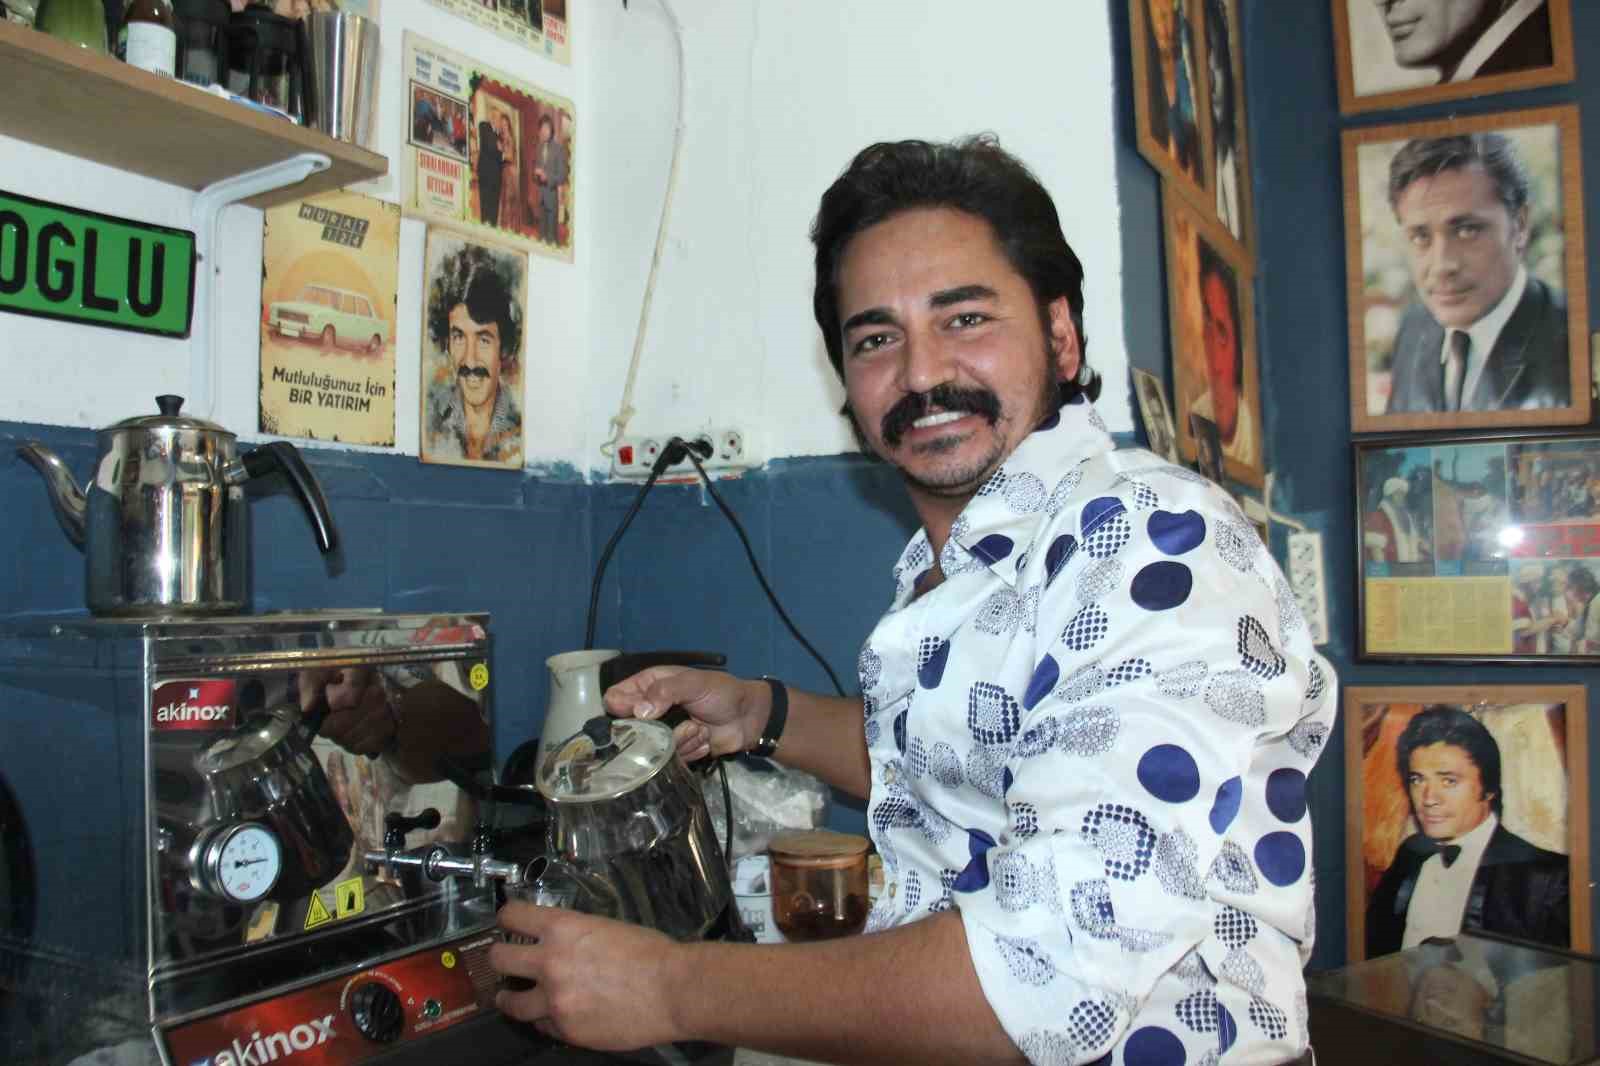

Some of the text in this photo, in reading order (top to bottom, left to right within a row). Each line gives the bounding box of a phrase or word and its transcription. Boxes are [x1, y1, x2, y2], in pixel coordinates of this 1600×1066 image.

[272, 366, 361, 393] Mutluluğunuz
[317, 391, 371, 413] YATIRIM
[157, 701, 230, 722] akinox
[214, 1014, 337, 1066] akinox
